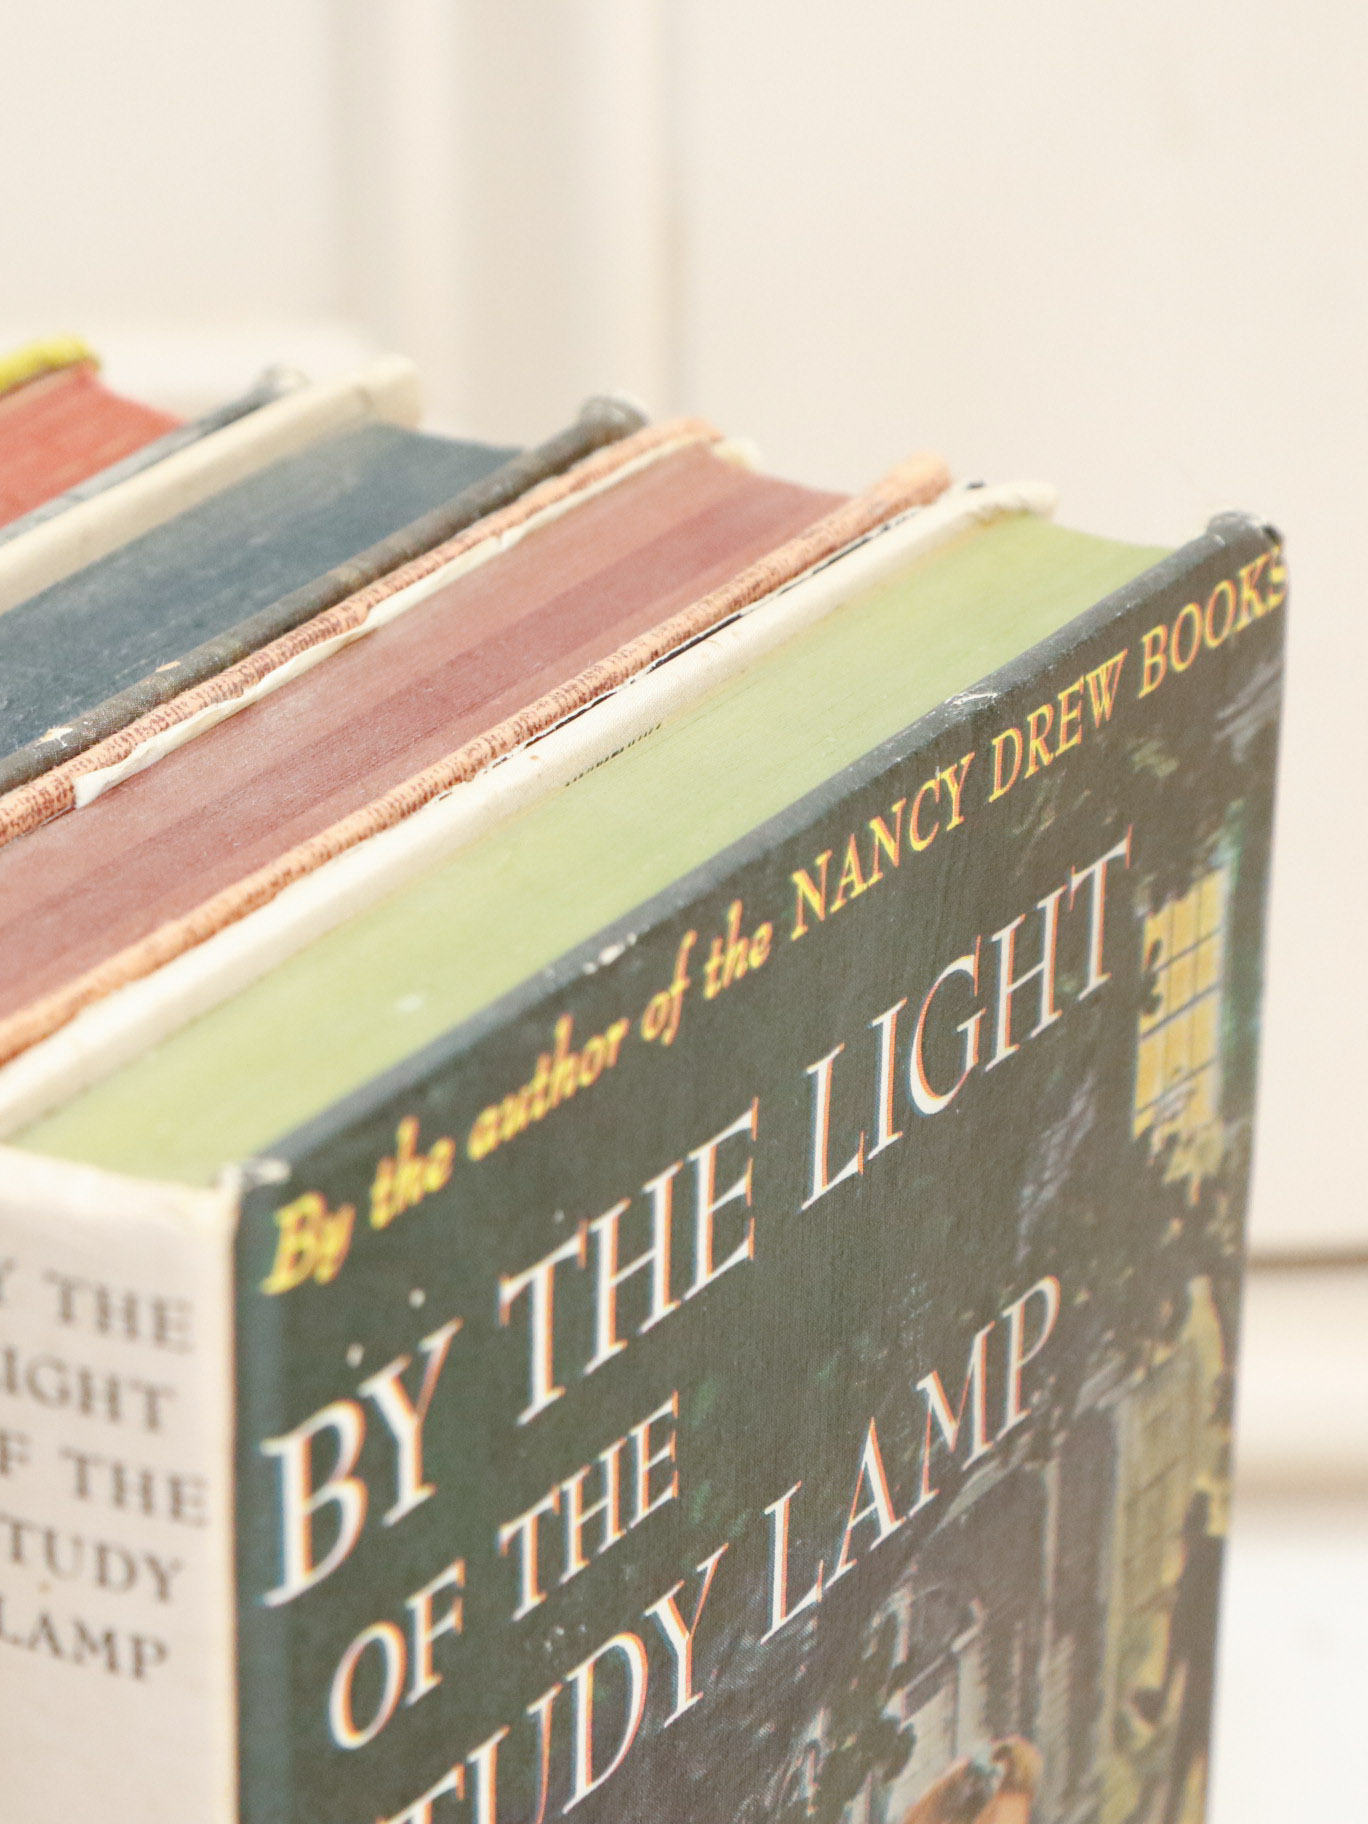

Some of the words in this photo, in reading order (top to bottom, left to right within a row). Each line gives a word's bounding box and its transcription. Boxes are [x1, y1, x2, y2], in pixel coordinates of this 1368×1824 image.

[261, 1190, 356, 1296] By
[368, 1115, 457, 1230] the
[467, 1013, 631, 1162] author
[640, 929, 698, 1046] of
[703, 899, 773, 1000] the
[790, 751, 975, 941] NANCY
[988, 647, 1129, 803] DREW
[1137, 543, 1287, 699] BOOKS
[41, 1268, 194, 1355] THE
[259, 1315, 463, 1608] BY
[497, 1095, 760, 1427] THE
[801, 824, 1132, 1212] LIGHT
[59, 1446, 210, 1529] THE
[327, 1557, 465, 1752] OF
[497, 1388, 679, 1622] THE
[760, 1275, 1060, 1644] LAMP
